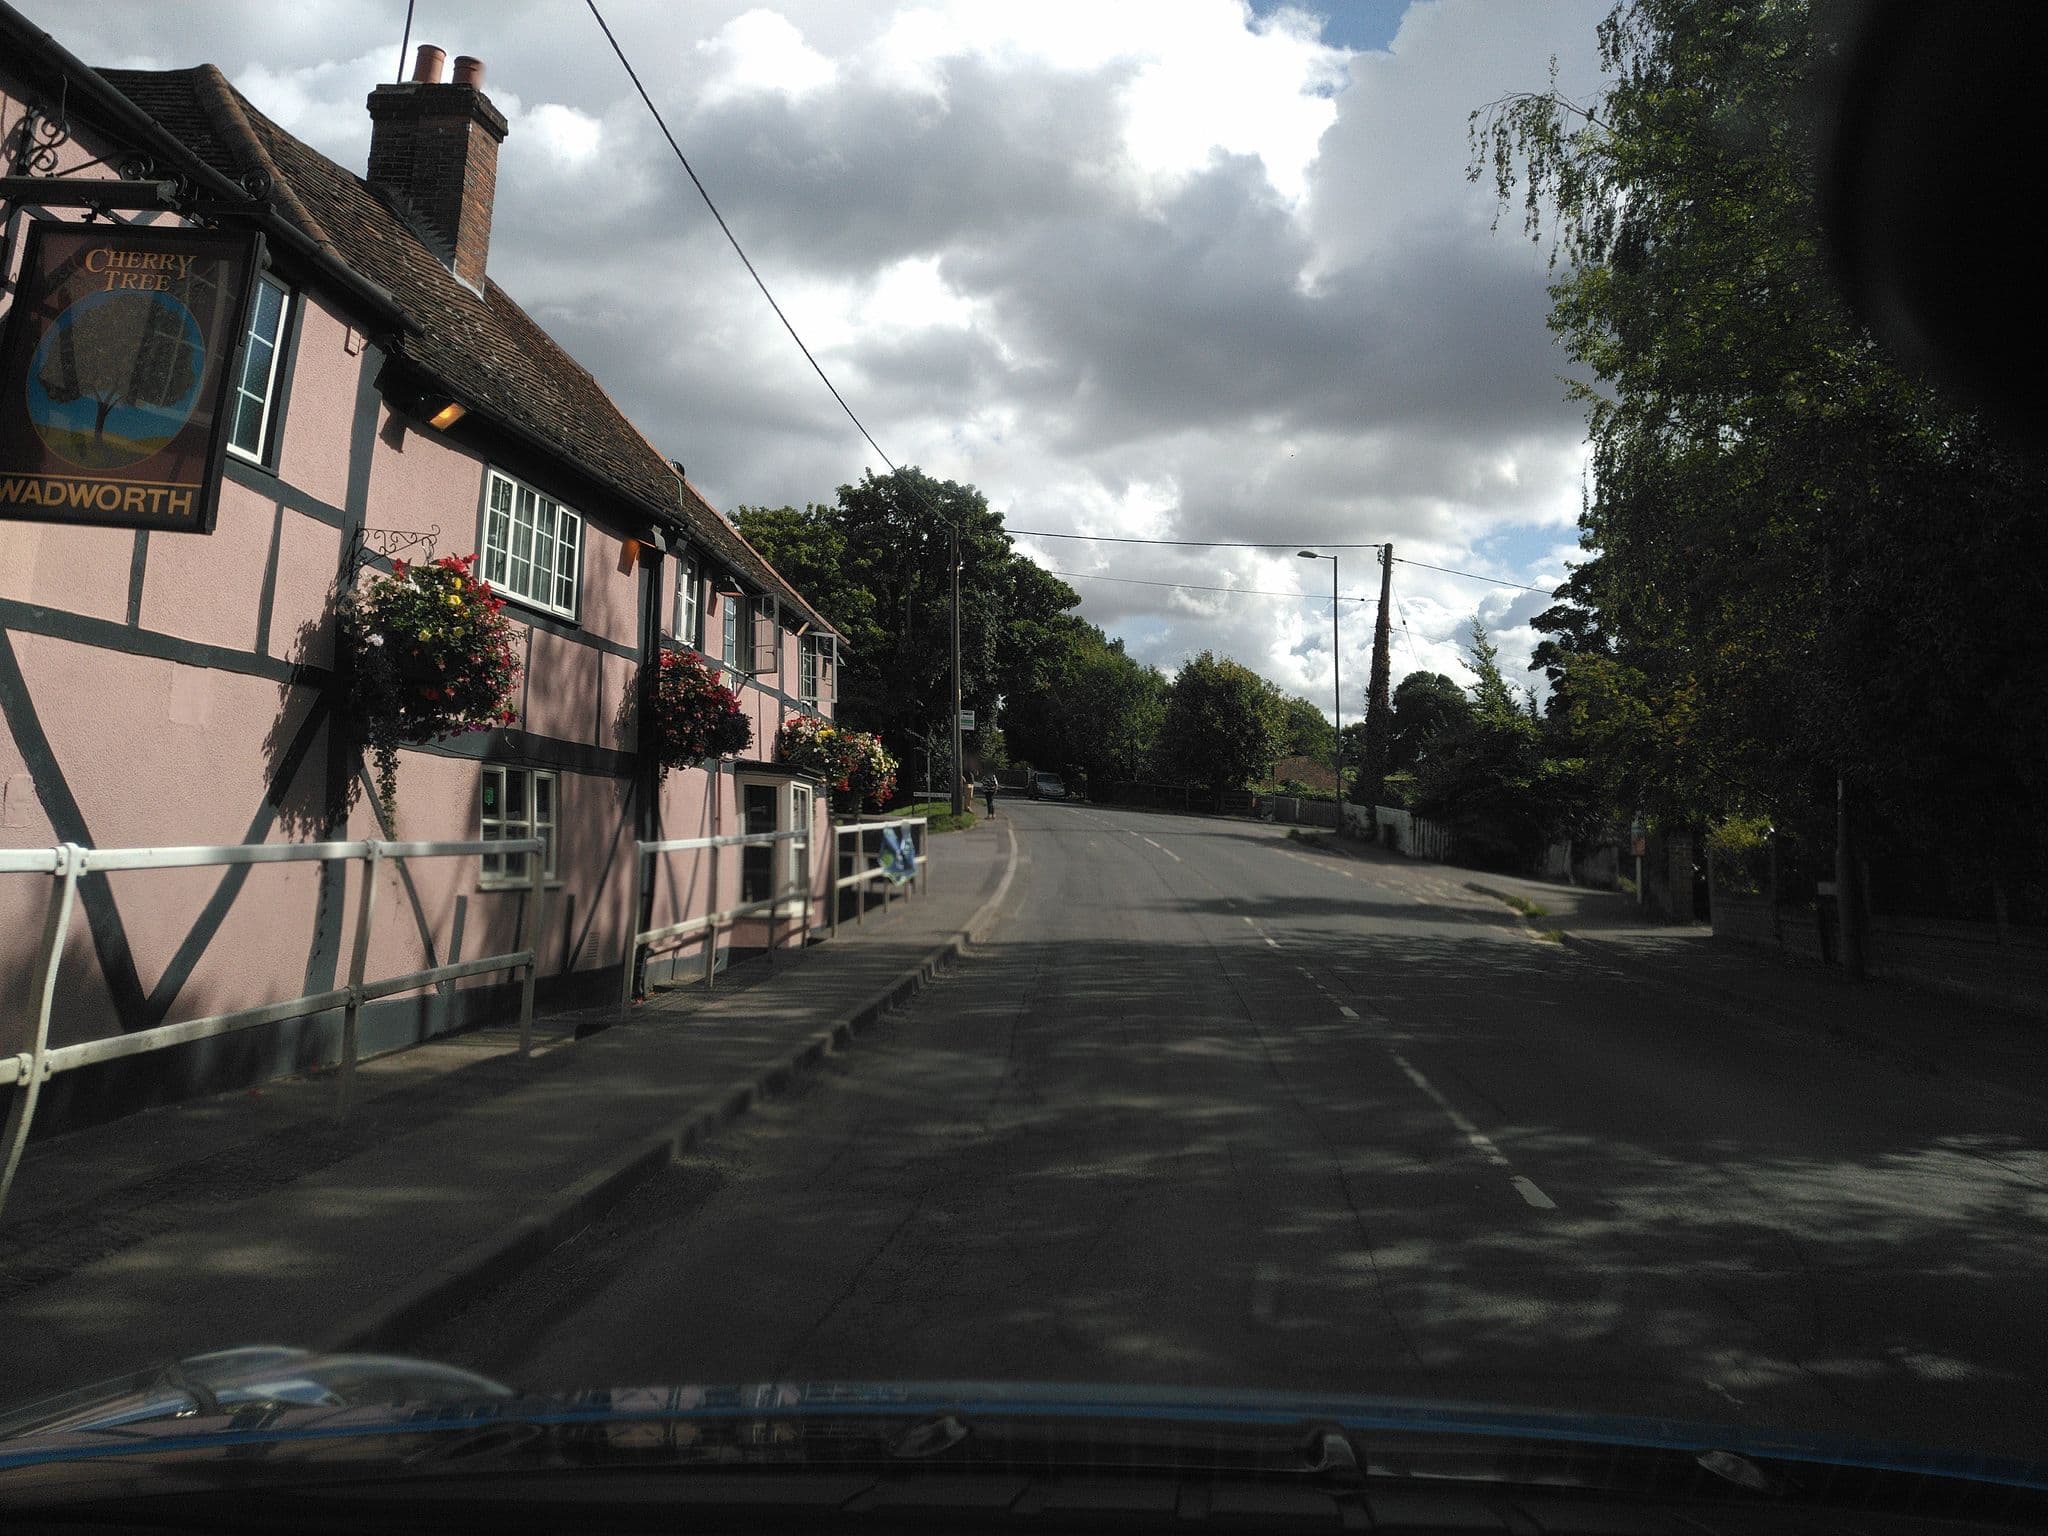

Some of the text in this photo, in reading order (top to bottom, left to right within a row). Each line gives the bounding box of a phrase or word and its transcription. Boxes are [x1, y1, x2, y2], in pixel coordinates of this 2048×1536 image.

[85, 249, 197, 280] CHERRY
[103, 270, 171, 292] TREE
[0, 479, 193, 515] WADWORTH
